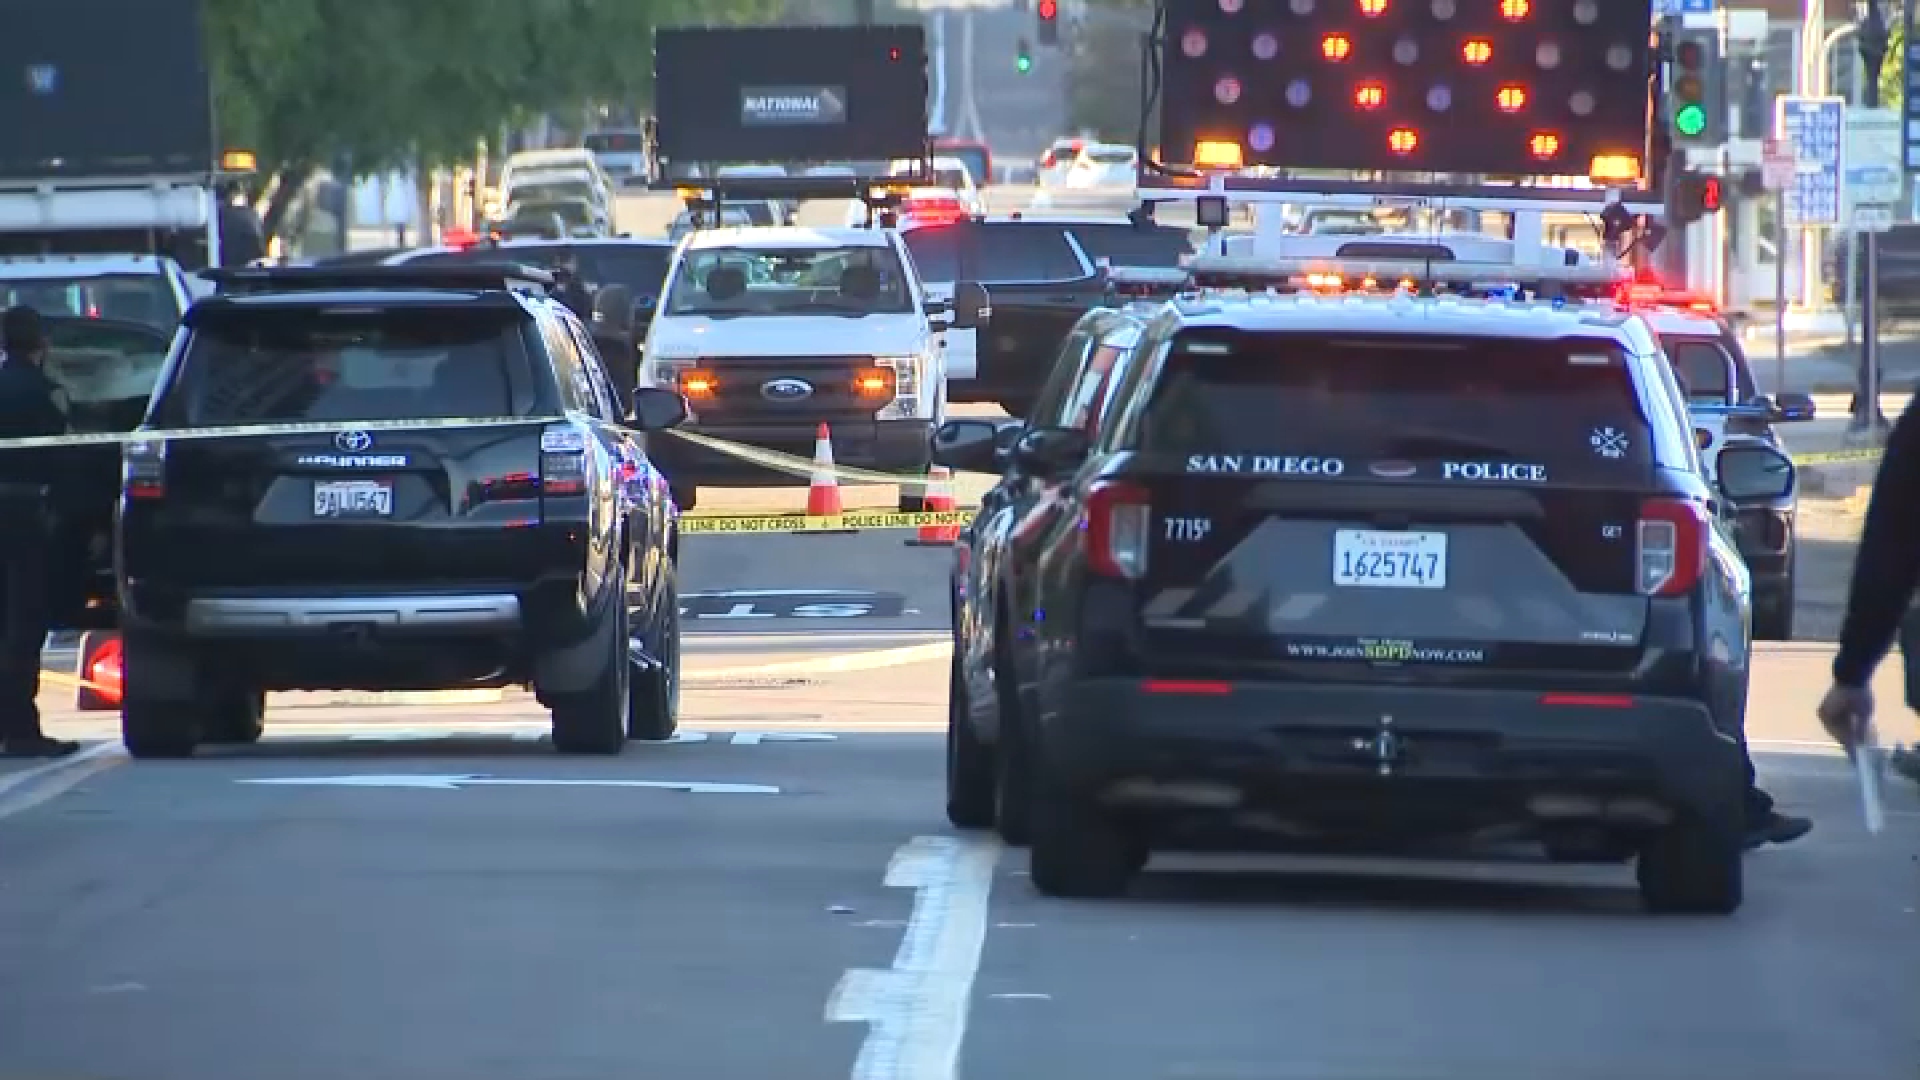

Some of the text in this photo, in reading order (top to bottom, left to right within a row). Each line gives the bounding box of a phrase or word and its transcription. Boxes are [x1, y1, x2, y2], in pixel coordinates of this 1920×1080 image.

[744, 96, 820, 112] NATIONAL
[1186, 454, 1345, 475] SAN DIEGO
[1443, 461, 1547, 481] POLICE
[689, 519, 715, 531] LINE
[719, 519, 737, 531] DO
[741, 519, 764, 531] NOT
[767, 518, 806, 530] CROSS
[841, 515, 884, 527] POLICE
[885, 514, 909, 526] LINE
[914, 514, 931, 526] DO
[935, 513, 959, 525] NOT
[1341, 551, 1438, 580] 1625747
